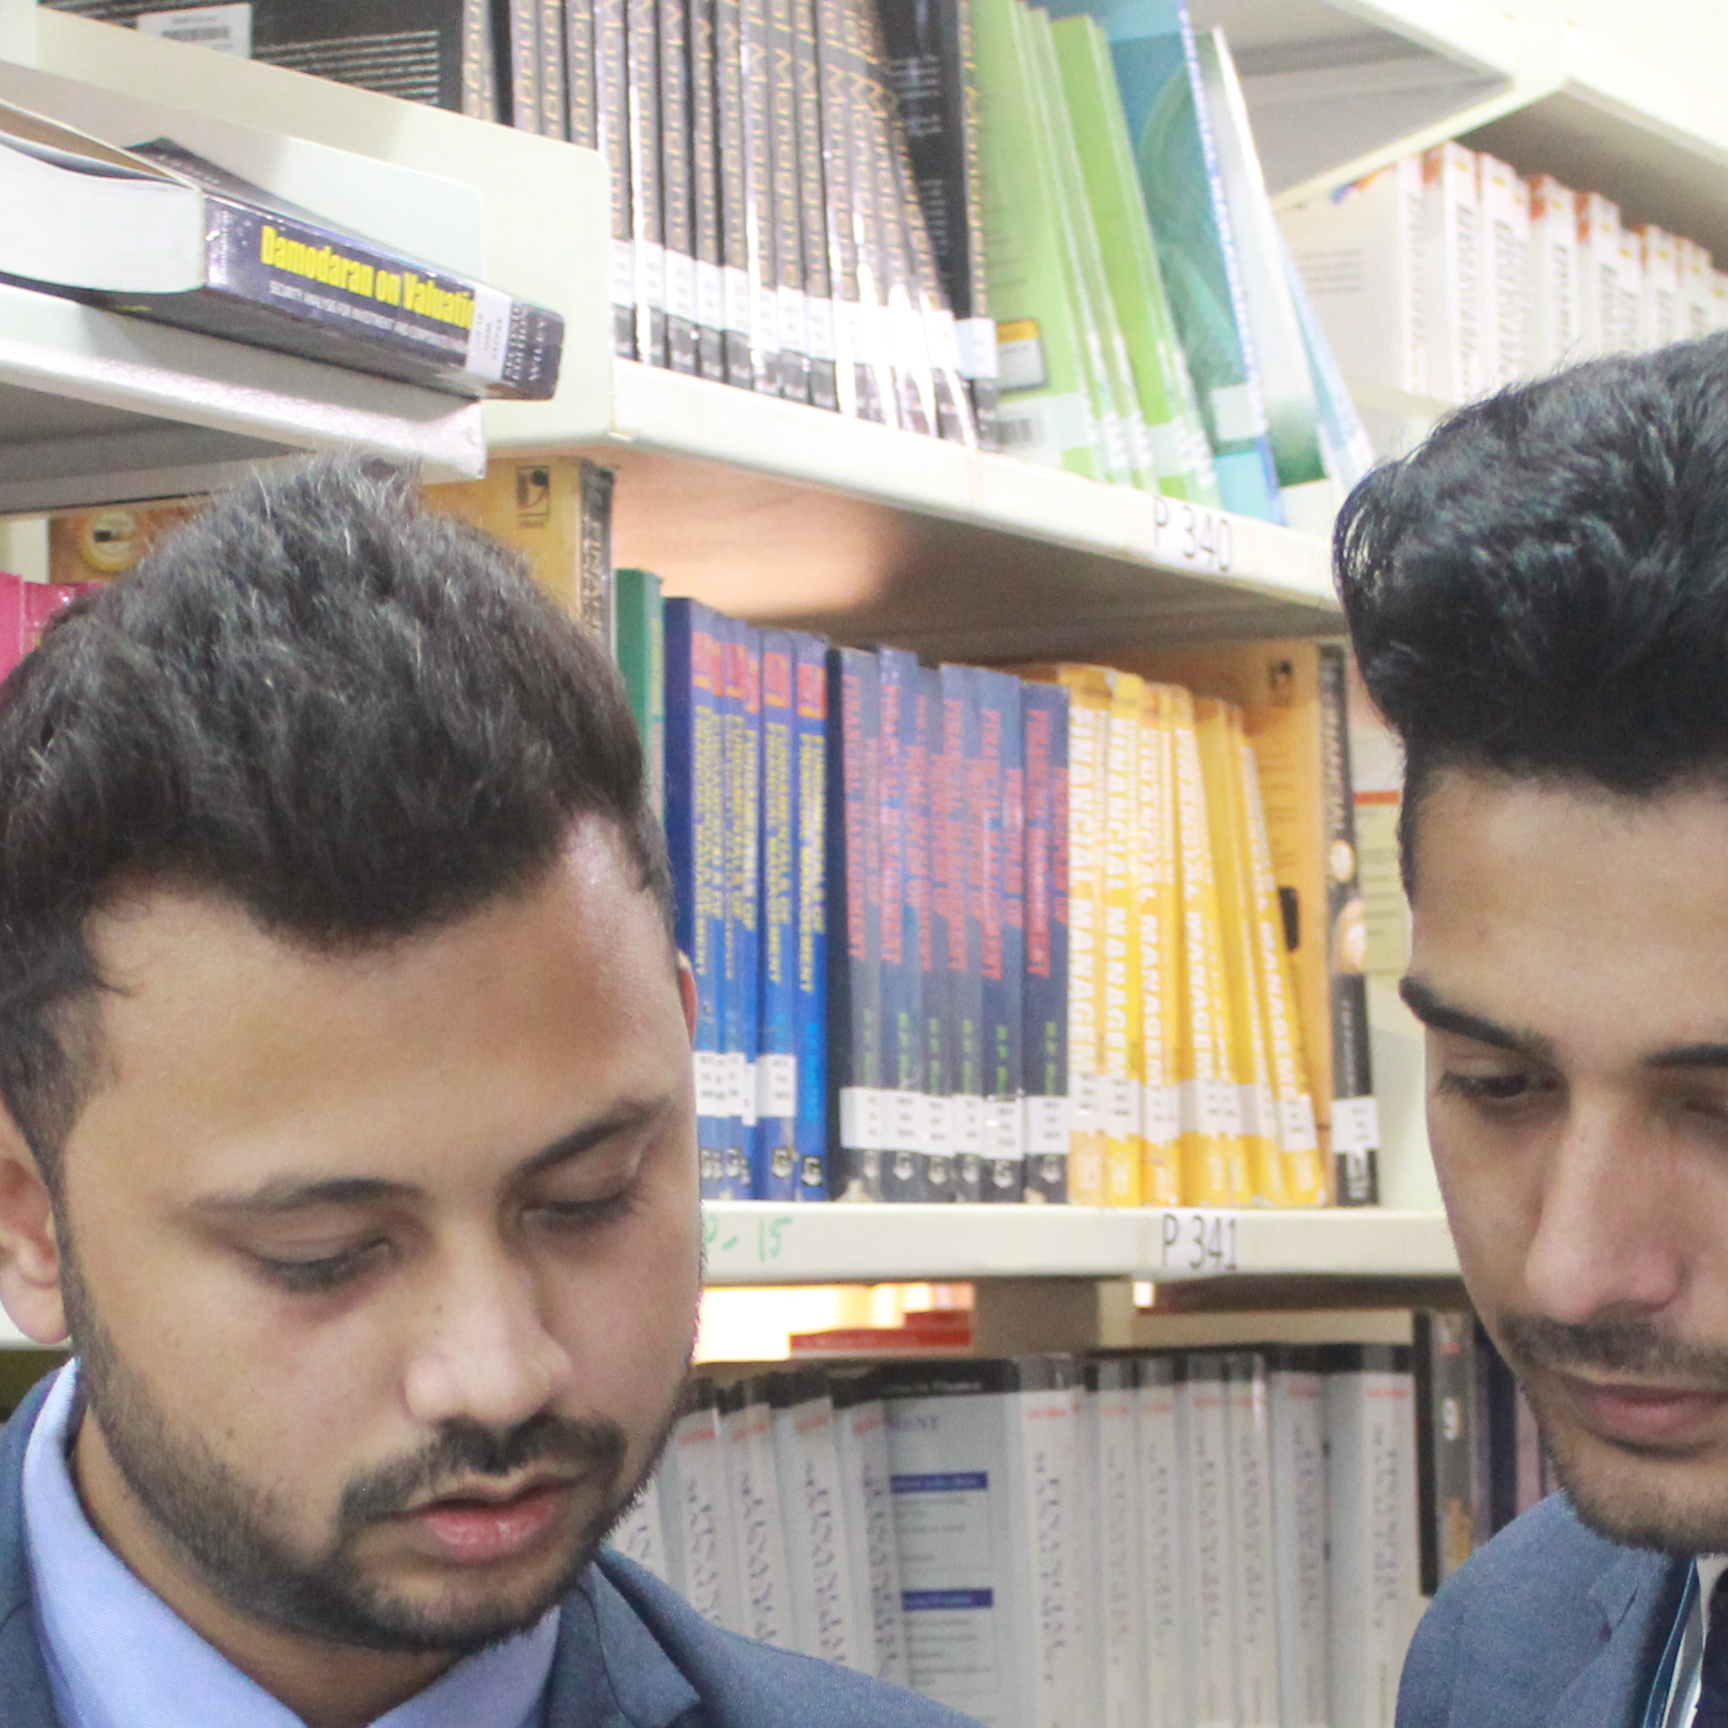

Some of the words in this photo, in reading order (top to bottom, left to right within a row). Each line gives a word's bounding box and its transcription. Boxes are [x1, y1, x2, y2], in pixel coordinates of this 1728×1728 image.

[261, 225, 374, 297] Damodaran
[374, 269, 401, 307] on
[1162, 1214, 1183, 1268] P
[1189, 1213, 1241, 1270] 341
